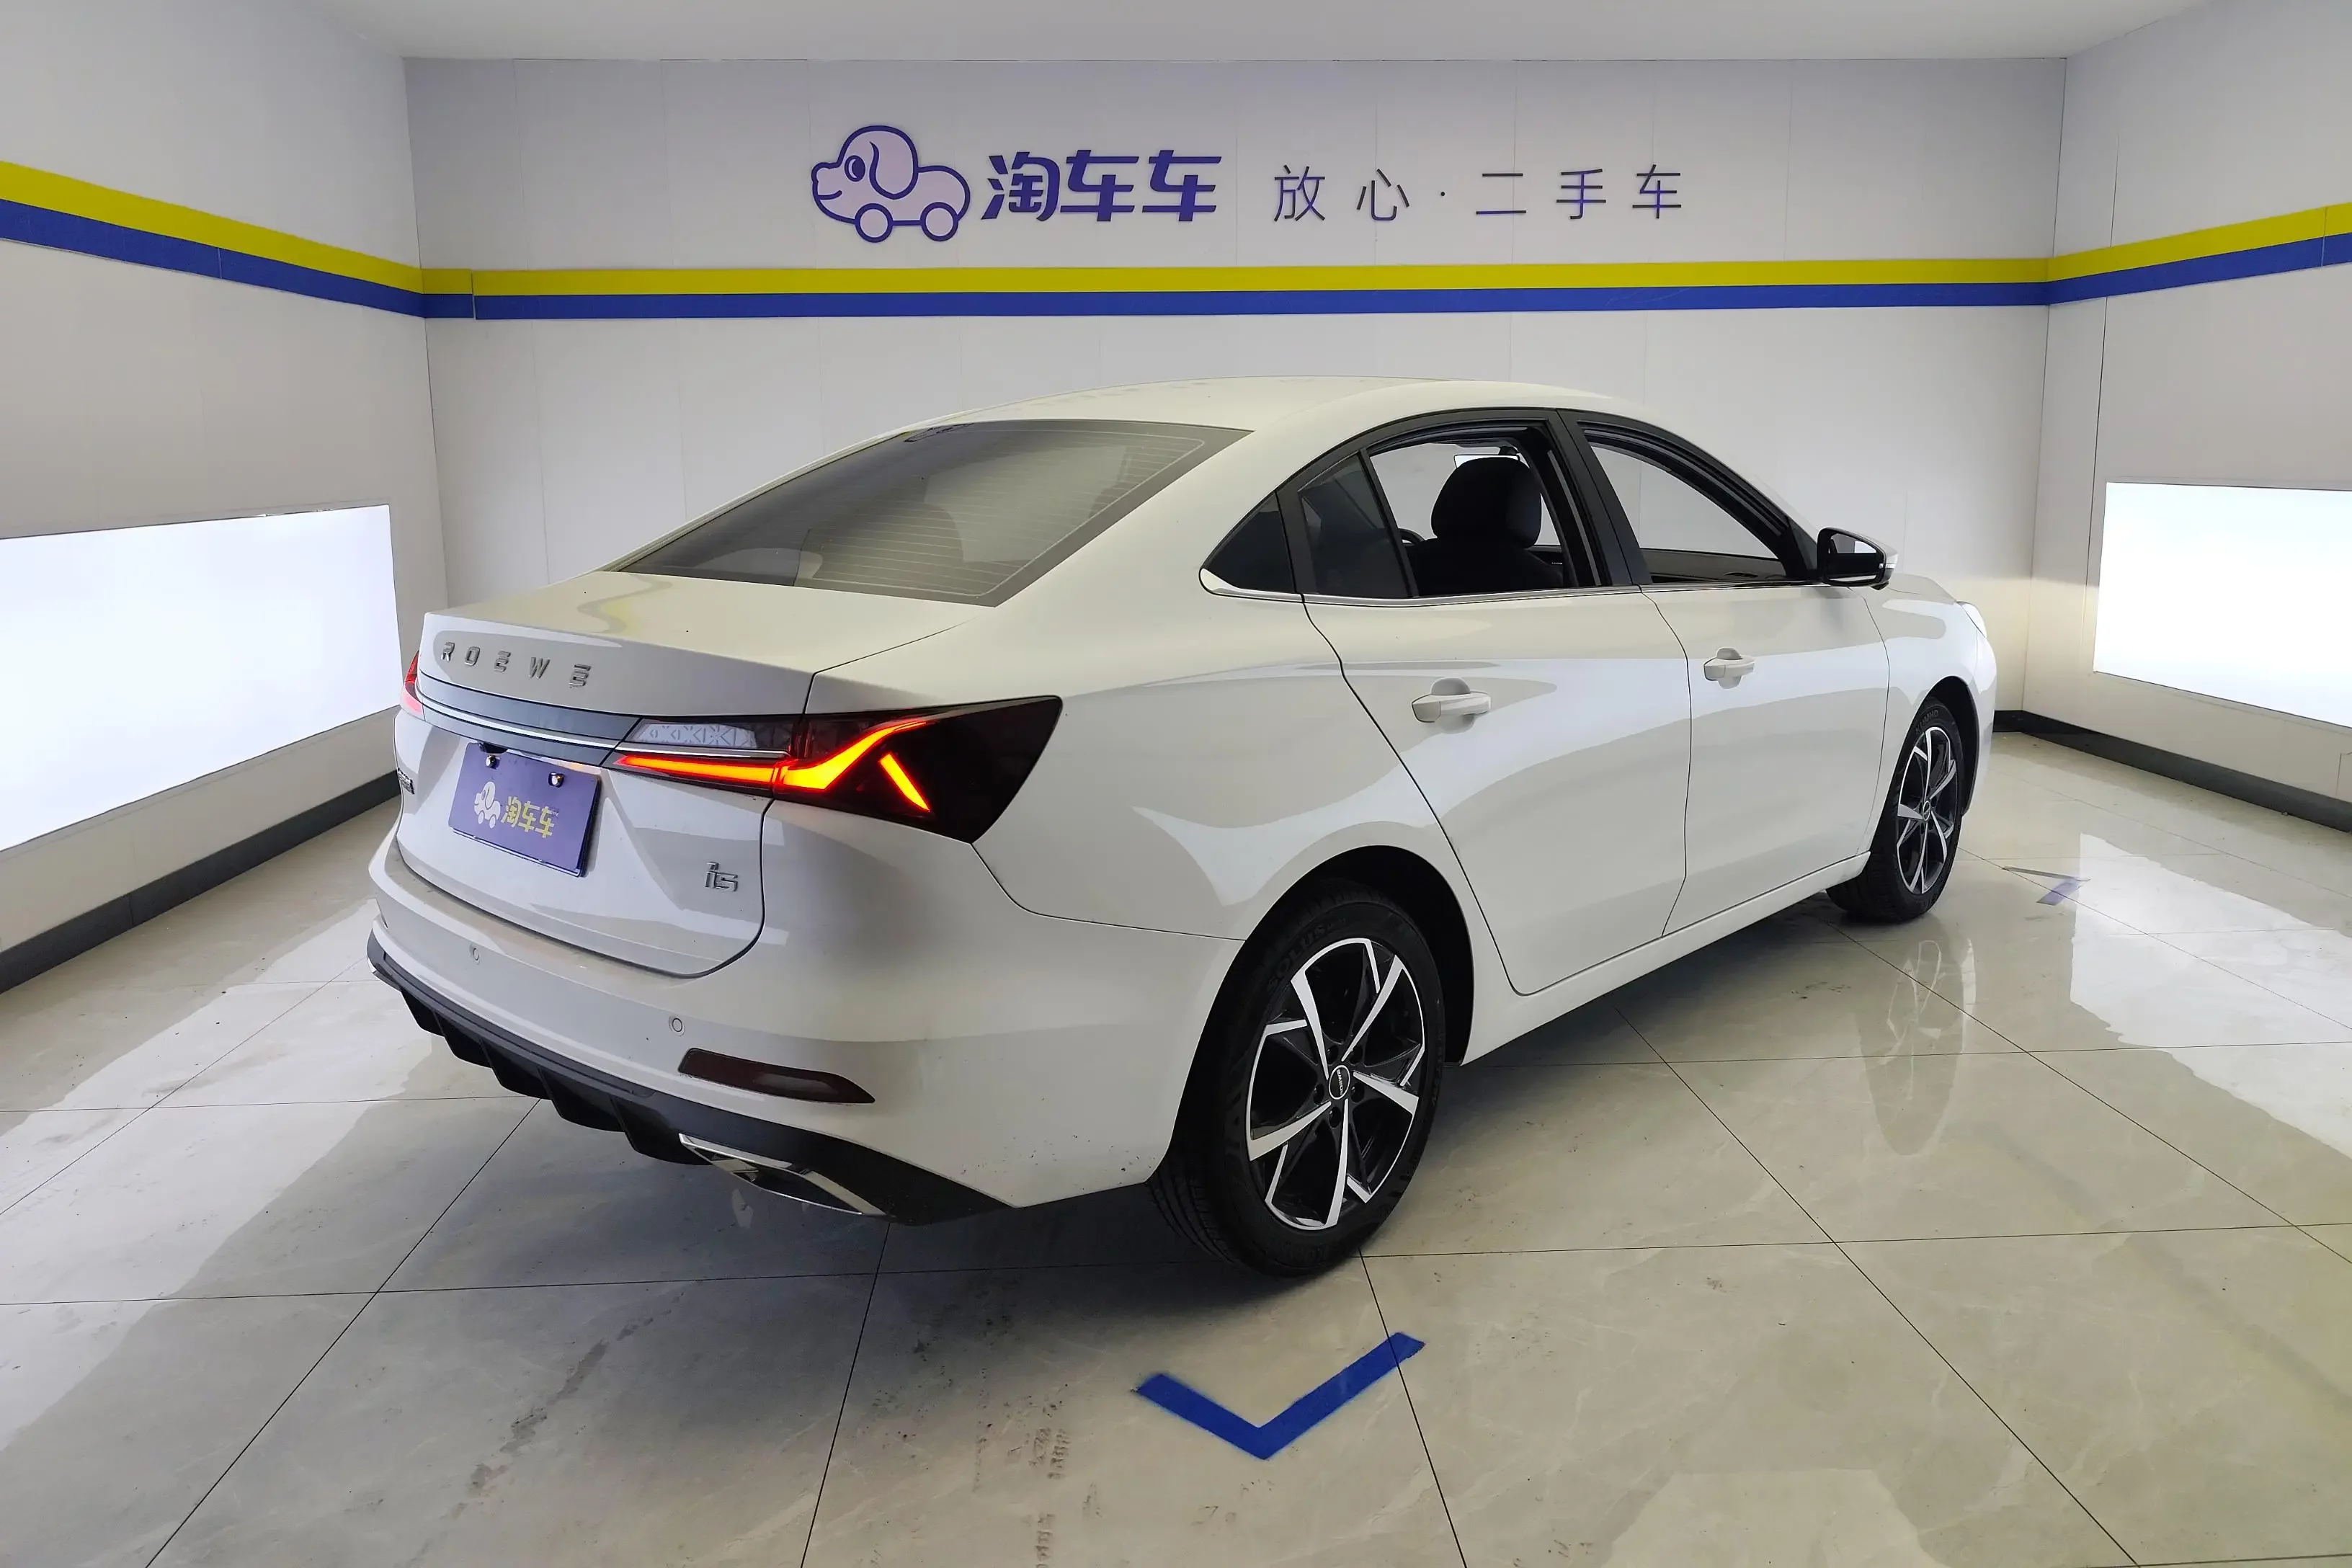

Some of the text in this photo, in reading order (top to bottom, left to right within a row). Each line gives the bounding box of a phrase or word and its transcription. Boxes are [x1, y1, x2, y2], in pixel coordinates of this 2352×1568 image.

[981, 149, 1222, 222] 淘车车
[440, 641, 592, 688] ROEWE
[500, 796, 559, 839] 淘车车
